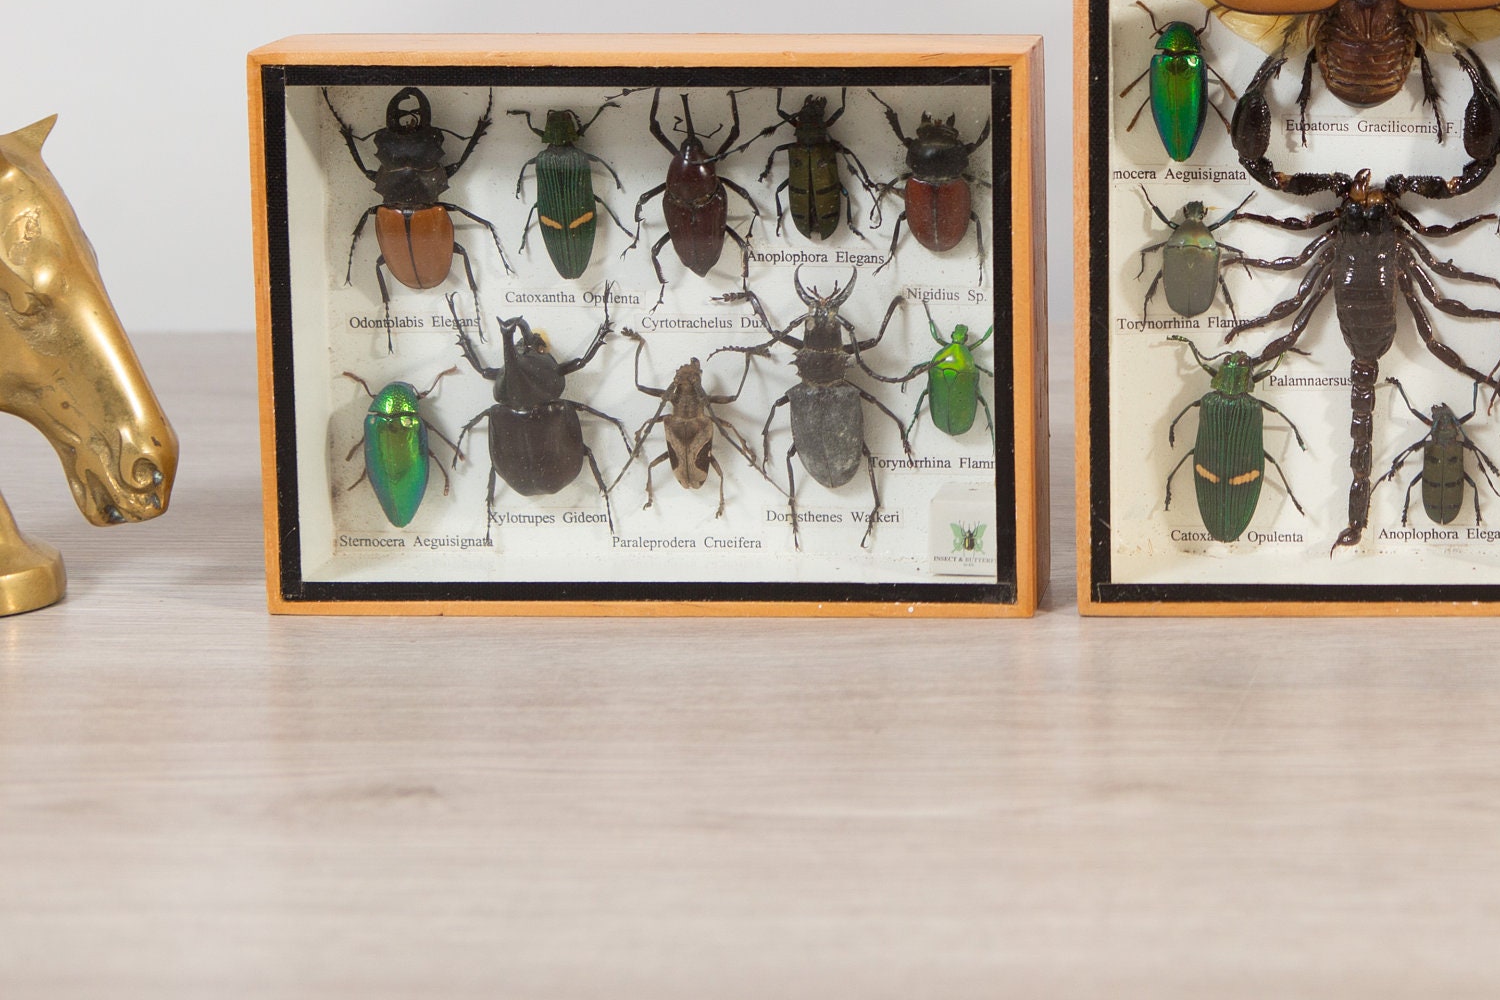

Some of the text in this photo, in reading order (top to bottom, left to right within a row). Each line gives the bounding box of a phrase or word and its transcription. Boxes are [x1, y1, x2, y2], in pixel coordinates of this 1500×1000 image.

[1357, 120, 1437, 134] Gracilicornis
[1164, 167, 1247, 182] Aeguisignata
[748, 250, 885, 266] Anoplophora Elegans
[505, 291, 576, 303] Catoxantha
[906, 287, 987, 304] Nigidius Sp.
[641, 316, 733, 331] Cyrtotrachelus
[1117, 317, 1200, 332] Torynorrhina
[869, 456, 952, 471] Torynorrhina
[489, 511, 608, 526] Xylotrupes Gideon
[766, 510, 900, 525] Dorsthenes Wakeri
[339, 535, 494, 550] Sternocera Aeguisignata
[1247, 530, 1304, 545] Opulenta
[1378, 528, 1459, 543] Anoplophora
[612, 536, 696, 551] Paraleprodera
